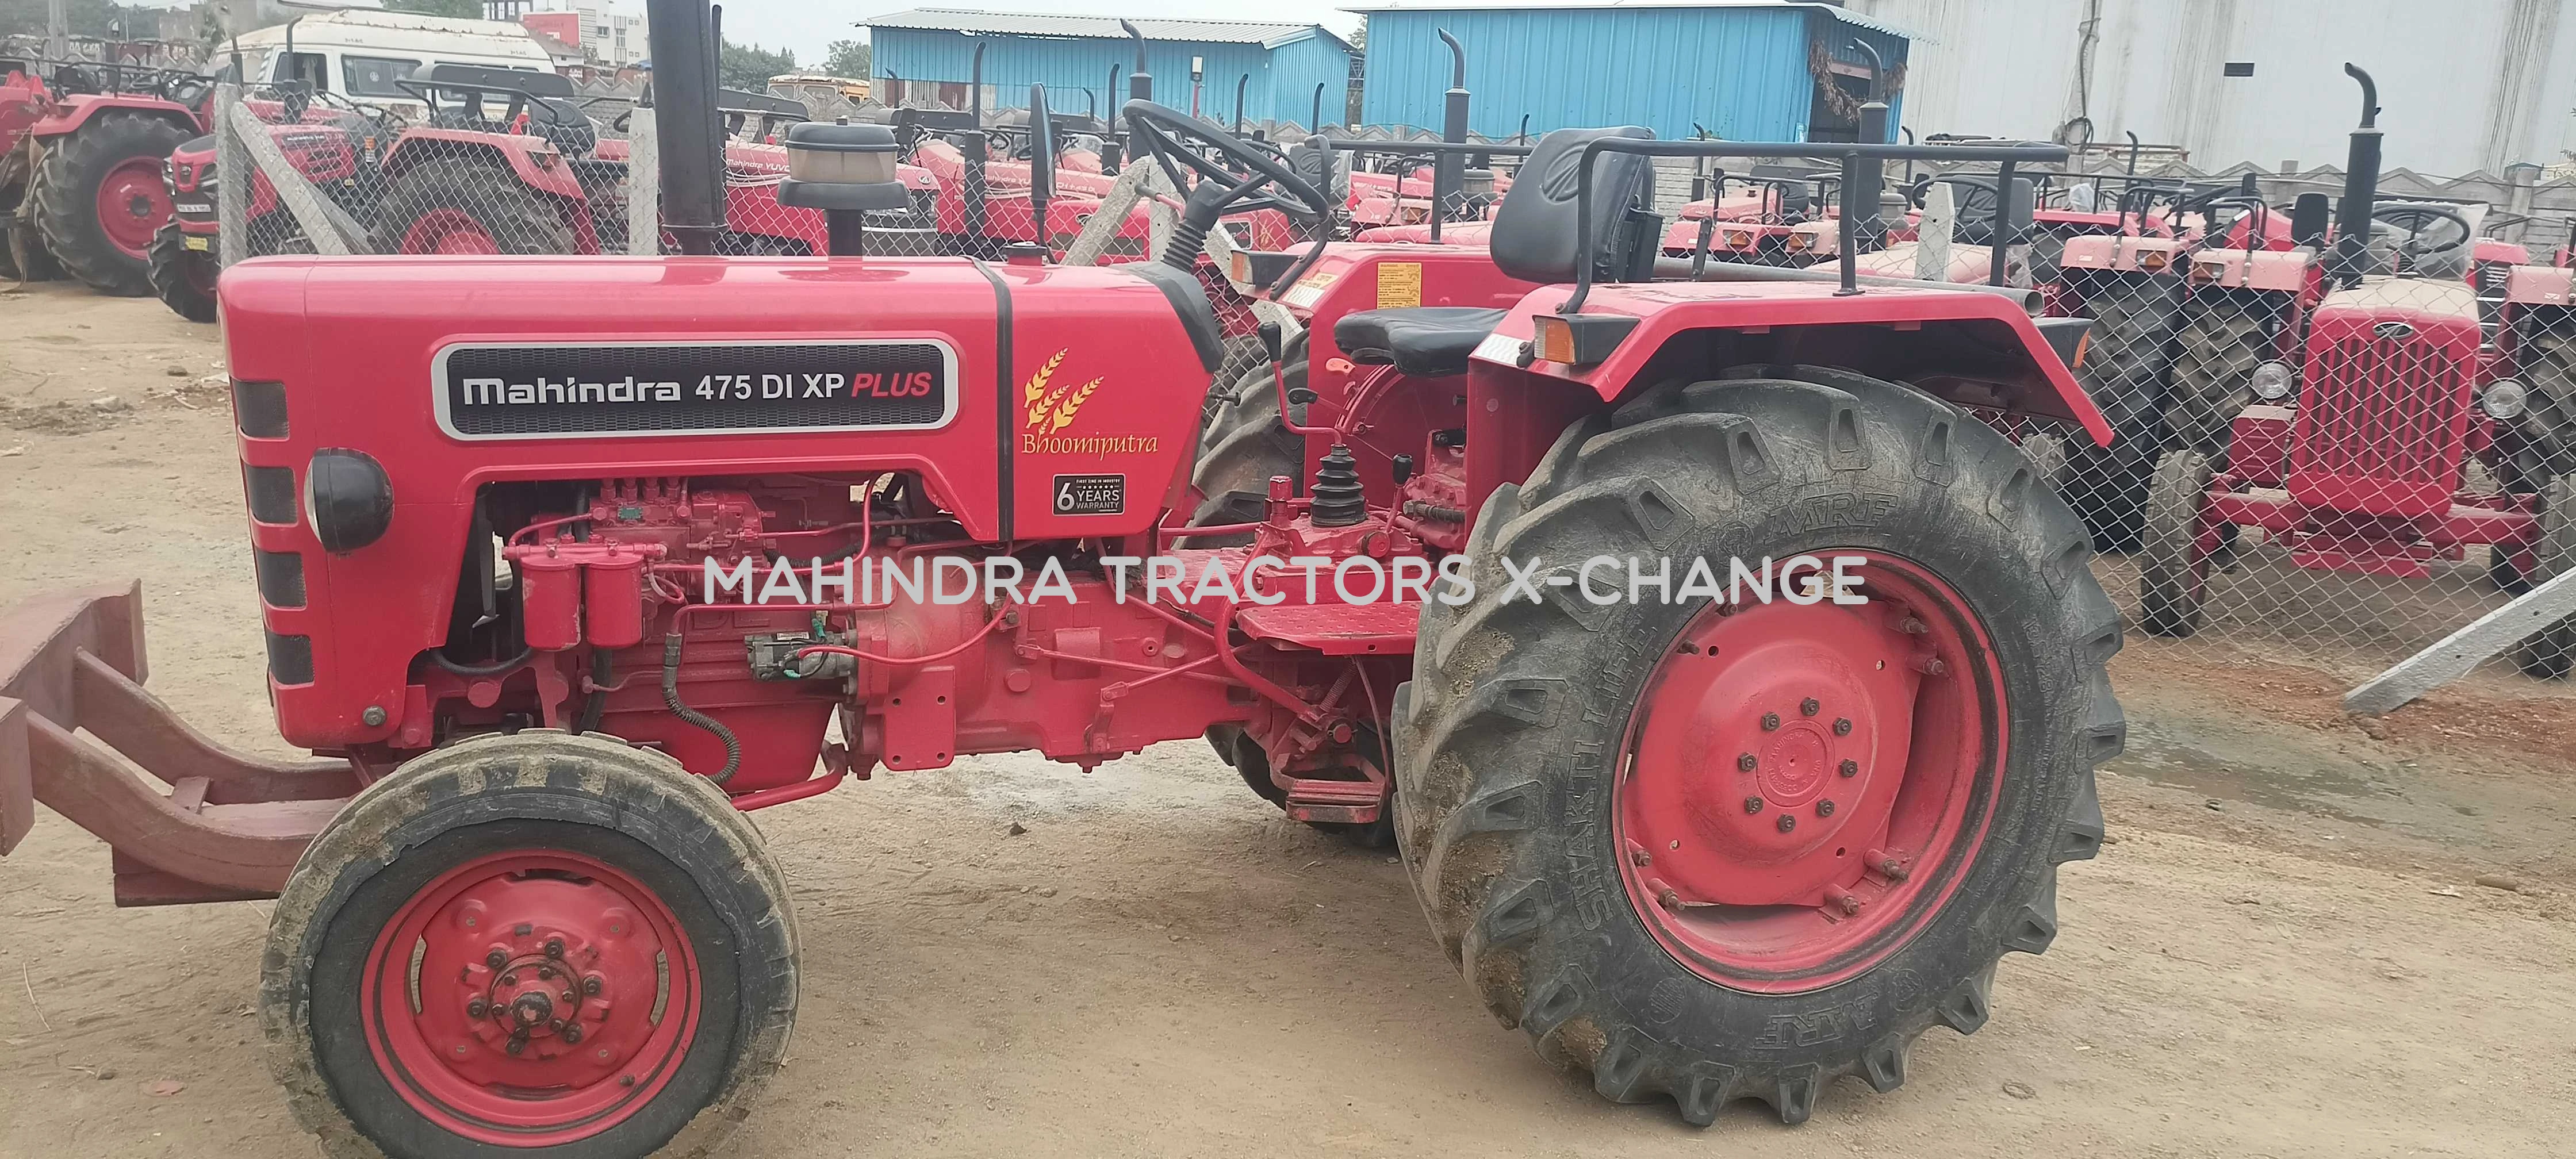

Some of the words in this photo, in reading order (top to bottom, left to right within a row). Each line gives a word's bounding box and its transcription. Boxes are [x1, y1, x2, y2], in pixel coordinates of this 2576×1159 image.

[695, 375, 752, 401] 475
[763, 374, 793, 400] DI
[802, 373, 846, 398] XP
[852, 372, 931, 397] PLUS
[1022, 431, 1158, 461] Bhoomiputra
[1057, 482, 1075, 511] 6
[1076, 490, 1120, 502] YEARS
[1076, 501, 1120, 509] WARRANTY
[1763, 492, 1898, 545] MRF
[1582, 625, 1658, 728] LIFE
[1563, 739, 1612, 931] SHAKTI
[1751, 991, 1880, 1050] MRF
